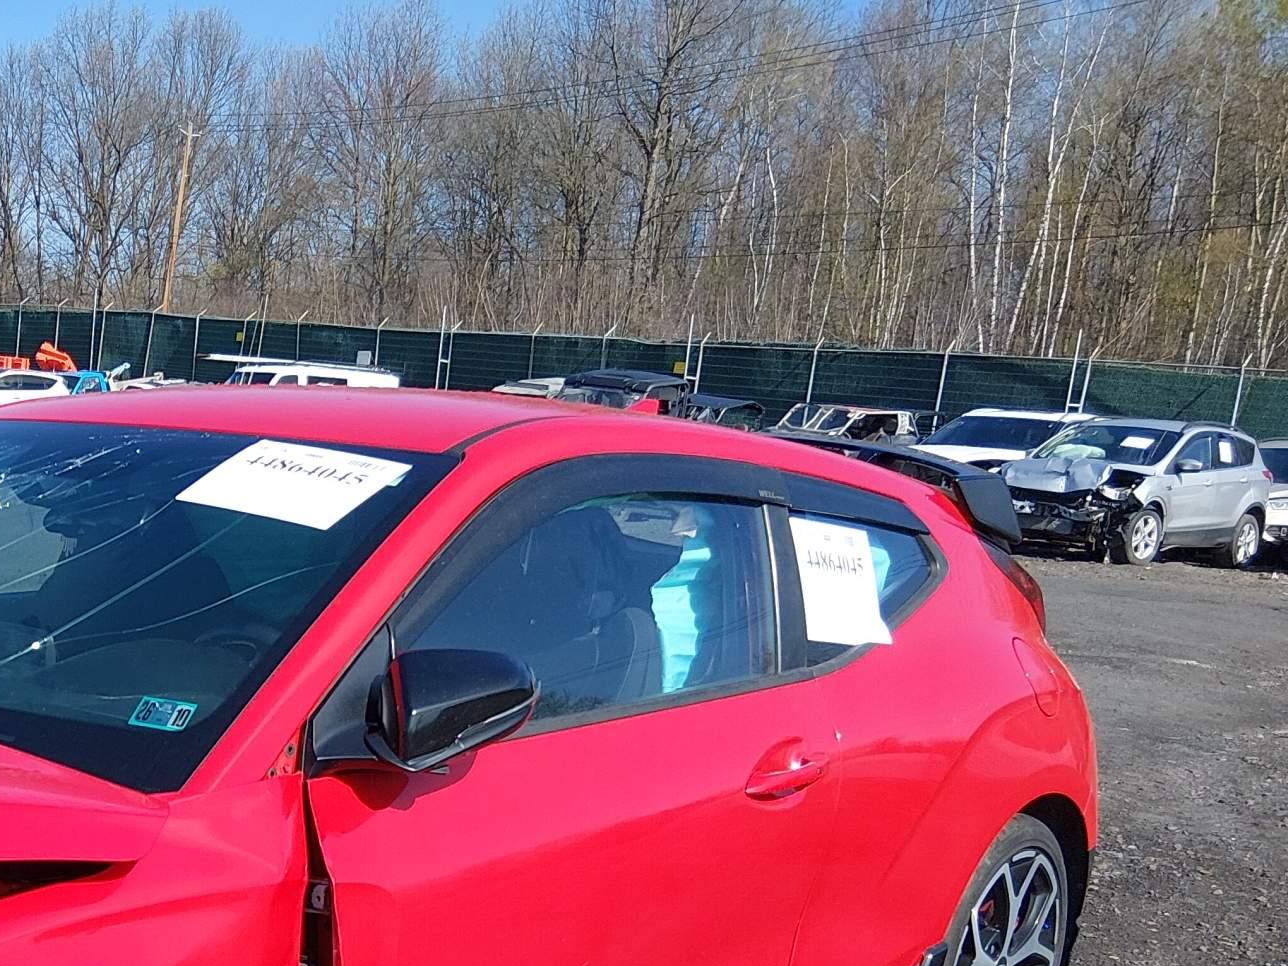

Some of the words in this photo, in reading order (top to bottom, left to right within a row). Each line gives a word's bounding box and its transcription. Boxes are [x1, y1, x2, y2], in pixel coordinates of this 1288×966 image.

[246, 455, 369, 485] 44864045
[806, 549, 864, 576] 44864045
[135, 701, 156, 721] 26
[169, 707, 192, 728] 10
